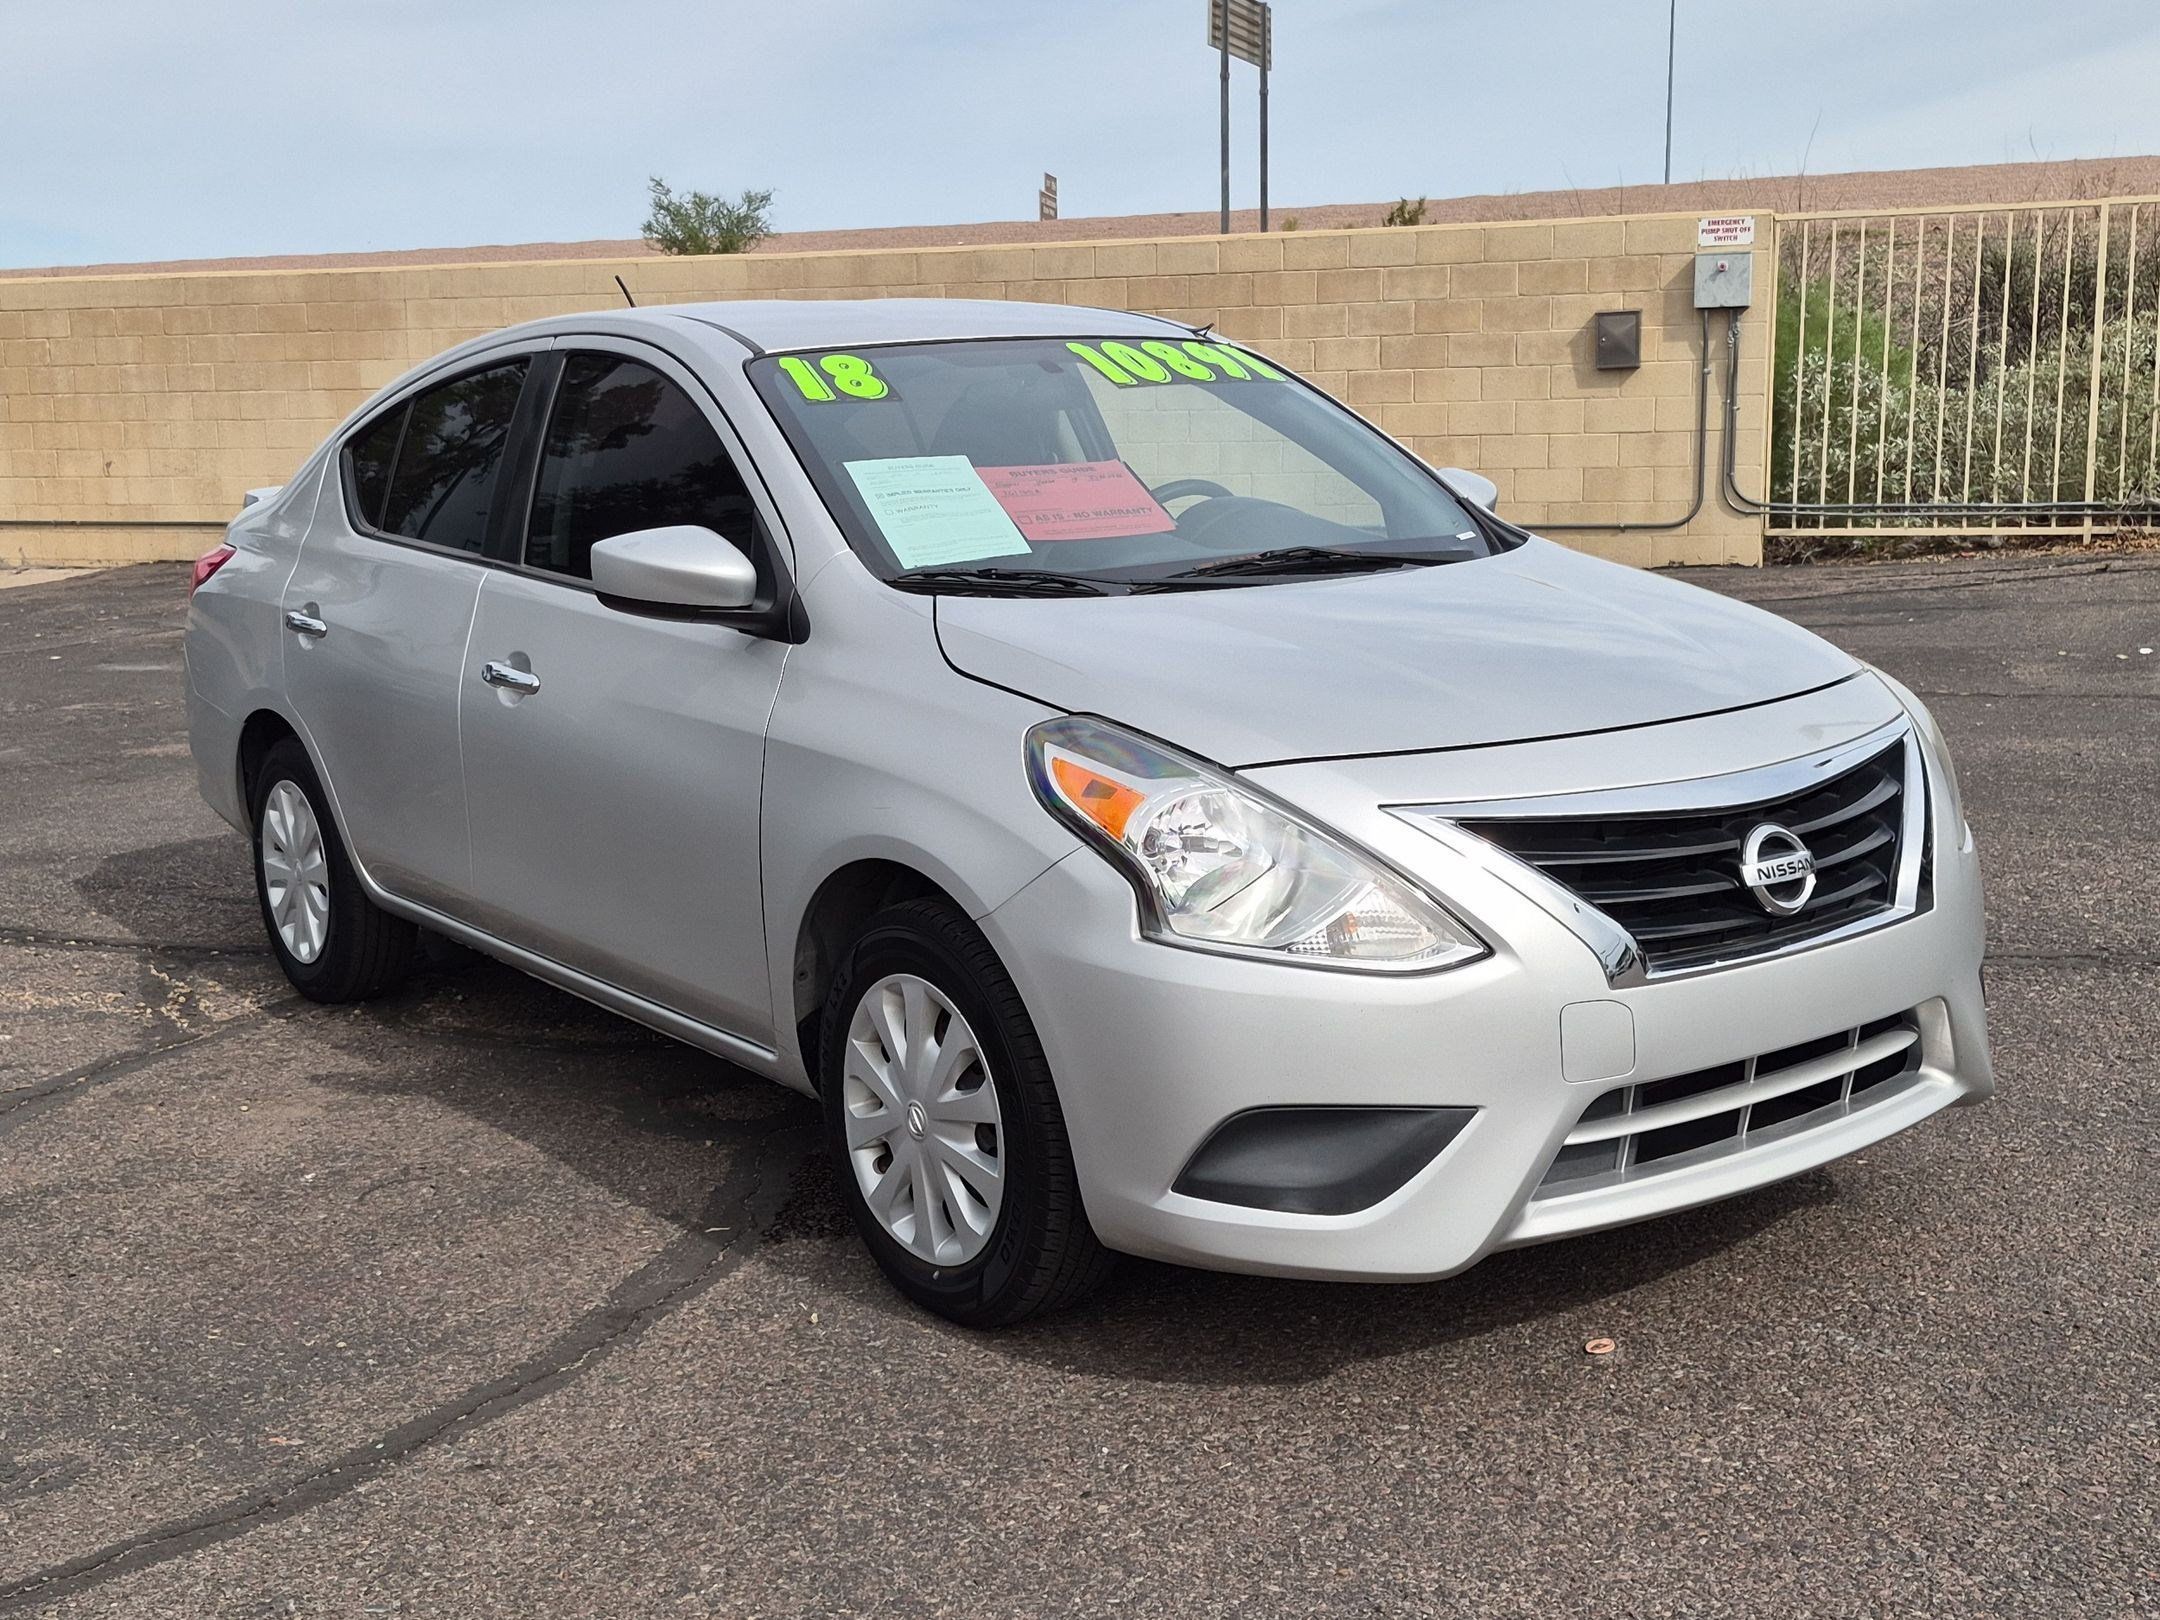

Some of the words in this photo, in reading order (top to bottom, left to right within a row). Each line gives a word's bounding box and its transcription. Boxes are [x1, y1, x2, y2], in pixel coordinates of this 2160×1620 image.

[778, 354, 889, 401] 18
[1009, 469, 1057, 477] BUYERS
[896, 504, 939, 513] WARRANTY
[1035, 514, 1050, 522] AS
[1052, 513, 1065, 521] IS
[1073, 511, 1090, 519] NO
[1093, 507, 1153, 517] WARRANTY
[1757, 857, 1811, 880] NISSAN
